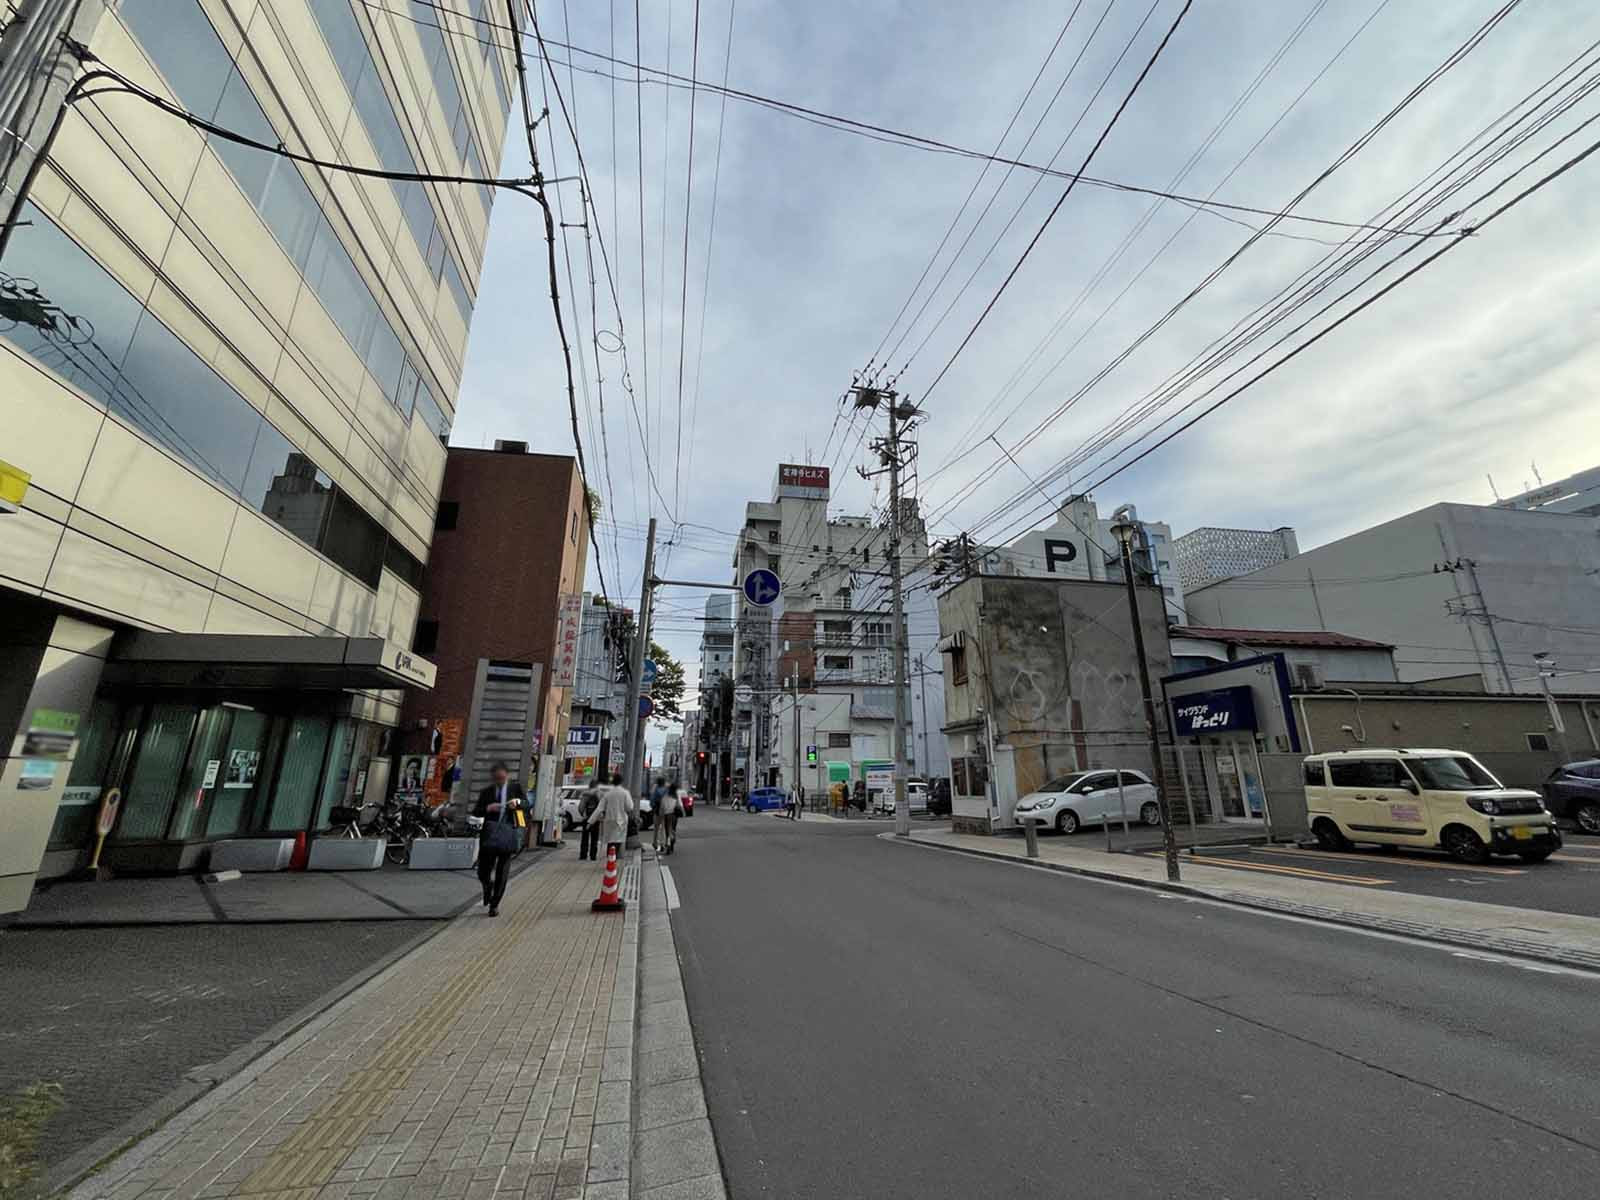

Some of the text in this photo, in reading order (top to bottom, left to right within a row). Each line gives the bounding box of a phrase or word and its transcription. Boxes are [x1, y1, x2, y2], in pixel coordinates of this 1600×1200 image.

[1044, 539, 1077, 572] P
[1191, 711, 1230, 729] はっとり
